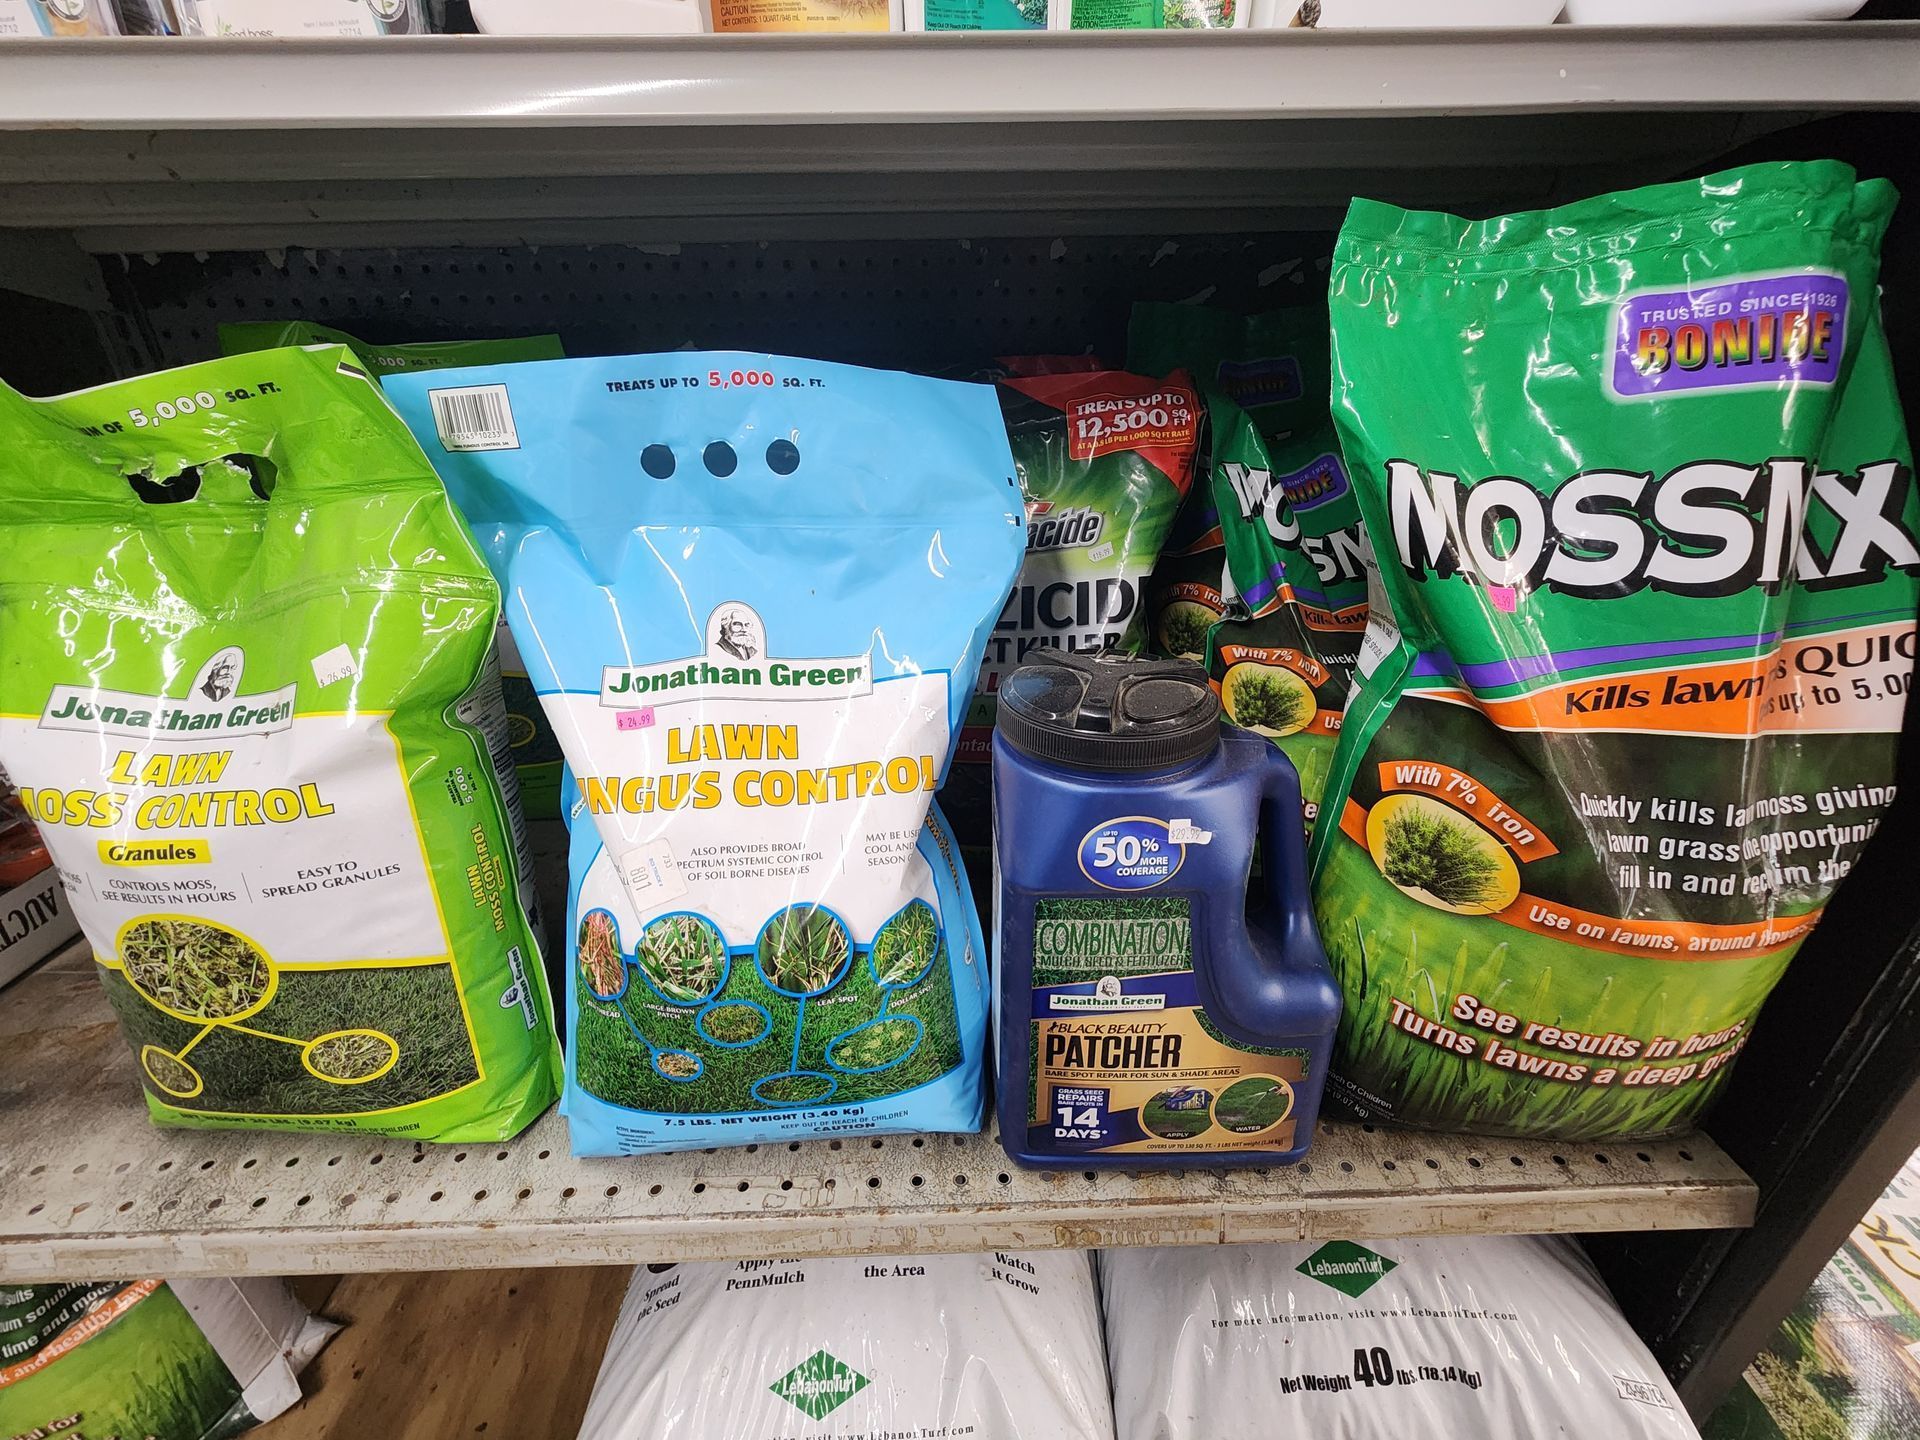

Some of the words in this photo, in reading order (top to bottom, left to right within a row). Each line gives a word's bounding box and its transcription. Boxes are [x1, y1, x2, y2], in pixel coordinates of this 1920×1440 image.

[720, 5, 749, 17] CAUTION
[722, 17, 731, 27] NET
[732, 16, 757, 26] CONTENTS:
[1072, 20, 1099, 29] CAUTION
[1641, 302, 1732, 324] TRUSTED
[1740, 293, 1803, 312] SINCE
[1809, 292, 1838, 308] 1926
[1637, 311, 1832, 377] BONIDE
[606, 379, 656, 393] TREATS
[660, 377, 678, 388] UP
[682, 377, 700, 388] TO
[708, 370, 776, 390] 5,000
[783, 378, 804, 388] SQ.
[809, 378, 825, 388] FT.
[103, 421, 124, 434] OF
[128, 391, 216, 428] 5,000
[225, 388, 255, 403] SQ.
[257, 381, 282, 395] FT.
[1076, 399, 1136, 416] TREATS
[1139, 393, 1162, 407] UP
[1164, 393, 1184, 405] TO
[1076, 408, 1168, 438] 12,500
[1172, 408, 1188, 418] SQ
[1174, 418, 1187, 426] FT
[1114, 434, 1128, 442] PER
[1129, 431, 1150, 441] 1,000
[1151, 431, 1161, 439] SQ
[1171, 428, 1190, 437] RATE
[1232, 647, 1267, 661] With
[1271, 649, 1293, 662] 7%
[608, 662, 762, 694] Jonathan
[769, 663, 864, 687] Green
[1566, 684, 1649, 715] Kills
[1661, 675, 1764, 706] lawn
[1812, 684, 1840, 706] to
[51, 696, 223, 732] Jonathan
[226, 700, 292, 727] Green
[627, 712, 652, 728] 24.99
[667, 723, 799, 764] LAWN
[106, 750, 233, 787] LAWN
[733, 755, 938, 808] CONTROL
[136, 782, 335, 830] CONTROL
[1395, 765, 1442, 788] With
[1446, 773, 1479, 805] 7%
[1486, 802, 1536, 846] iron
[1580, 791, 1642, 824] Quickly
[1650, 797, 1716, 826] kills
[1756, 793, 1809, 818] moss
[865, 832, 887, 842] MAY
[889, 831, 901, 840] BE
[1170, 827, 1200, 841] $29.99
[108, 844, 197, 861] Granules
[470, 822, 498, 890] CONTROL
[690, 847, 717, 857] ALSO
[720, 845, 769, 855] PROVIDES
[864, 844, 895, 855] COOL
[895, 841, 915, 851] AND
[1093, 836, 1159, 868] 50%
[1606, 830, 1649, 854] lawn
[1658, 836, 1740, 864] grass
[297, 865, 333, 880] EASY
[335, 860, 358, 873] TO
[727, 856, 775, 868] SYSTEMIC
[867, 856, 906, 867] SEASON
[1117, 866, 1168, 877] COVERAGE
[1140, 857, 1168, 866] MORE
[109, 879, 170, 891] CONTROLS
[174, 879, 217, 890] MOSS,
[262, 881, 318, 898] SPREAD
[322, 863, 401, 889] GRANULES
[687, 871, 702, 881] OF
[705, 869, 728, 880] SOIL
[730, 868, 765, 879] BORNE
[1618, 864, 1641, 890] fill
[1649, 865, 1671, 889] in
[1682, 872, 1736, 896] and
[466, 864, 488, 908] LAWN
[102, 891, 119, 901] SEE
[121, 892, 166, 904] RESULTS
[168, 894, 183, 904] IN
[187, 891, 237, 902] HOURS
[489, 891, 506, 933] MOSS
[1039, 921, 1187, 956] COMBINATION
[1528, 905, 1572, 931] Use
[1576, 922, 1605, 940] on
[1610, 927, 1680, 953] lawns,
[1688, 931, 1756, 953] around
[514, 948, 527, 981] Green
[1085, 955, 1113, 967] SEED
[1115, 955, 1123, 967] &
[1127, 954, 1185, 967] FERTILIZER
[817, 997, 835, 1007] LEAF
[837, 995, 859, 1003] SPOT
[891, 993, 918, 1008] DOLLAR
[918, 983, 935, 995] SPOT
[1052, 996, 1119, 1006] Jonathan
[1121, 996, 1163, 1006] Green
[642, 1002, 664, 1011] LARGE
[666, 1006, 695, 1014] BROWN
[657, 1011, 680, 1019] PATCH
[1058, 1023, 1106, 1034] BLACK
[1107, 1022, 1168, 1034] BEAUTY
[1453, 993, 1519, 1035] See
[1523, 1020, 1643, 1060] results
[1644, 1035, 1681, 1059] in
[1045, 1034, 1183, 1069] PATCHER
[1391, 996, 1477, 1055] Turns
[1482, 1039, 1588, 1082] lawns
[1594, 1066, 1618, 1085] a
[1624, 1062, 1705, 1087] deep
[1096, 1071, 1128, 1079] REPAIR
[1212, 1068, 1240, 1076] AREAS
[1058, 1094, 1104, 1103] REPAIRS
[1357, 1087, 1392, 1110] Children
[664, 1118, 686, 1127] 7.5
[690, 1117, 717, 1126] LBS.
[720, 1116, 744, 1126] NET
[748, 1112, 798, 1123] WEIGHT
[802, 1109, 838, 1120] (3.40
[842, 1106, 865, 1117] Kg)
[780, 1122, 800, 1130] KEEP
[802, 1121, 818, 1129] OUT
[833, 1118, 857, 1127] REACH
[858, 1116, 869, 1124] OF
[871, 1109, 909, 1122] CHILDREN
[1058, 1106, 1100, 1128] 14
[1354, 1103, 1369, 1118] kg)
[380, 1122, 421, 1134] CHILDREN
[813, 1122, 876, 1132] CAUTION
[864, 1265, 888, 1278] the
[891, 1263, 926, 1277] Area
[995, 1251, 1036, 1276] Watch
[1308, 1256, 1385, 1277] LebanonTurf
[644, 1273, 680, 1303] Spread
[725, 1270, 805, 1292] PennMulch
[992, 1267, 1003, 1280] it
[1005, 1272, 1041, 1296] Grow
[654, 1291, 682, 1313] Seed
[42, 1308, 71, 1337] and
[1212, 1318, 1229, 1329] For
[1348, 1308, 1375, 1319] visit
[1380, 1306, 1519, 1322] www.LebanonTurf.com
[14, 1350, 48, 1377] and
[50, 1307, 114, 1357] healthy
[1280, 1376, 1302, 1394] Net
[1302, 1373, 1352, 1393] Weight
[1354, 1346, 1395, 1388] 40
[1396, 1369, 1418, 1385] lbs.
[1417, 1366, 1457, 1382] (18.14
[1458, 1367, 1483, 1390] Kg)
[47, 1413, 78, 1432] for
